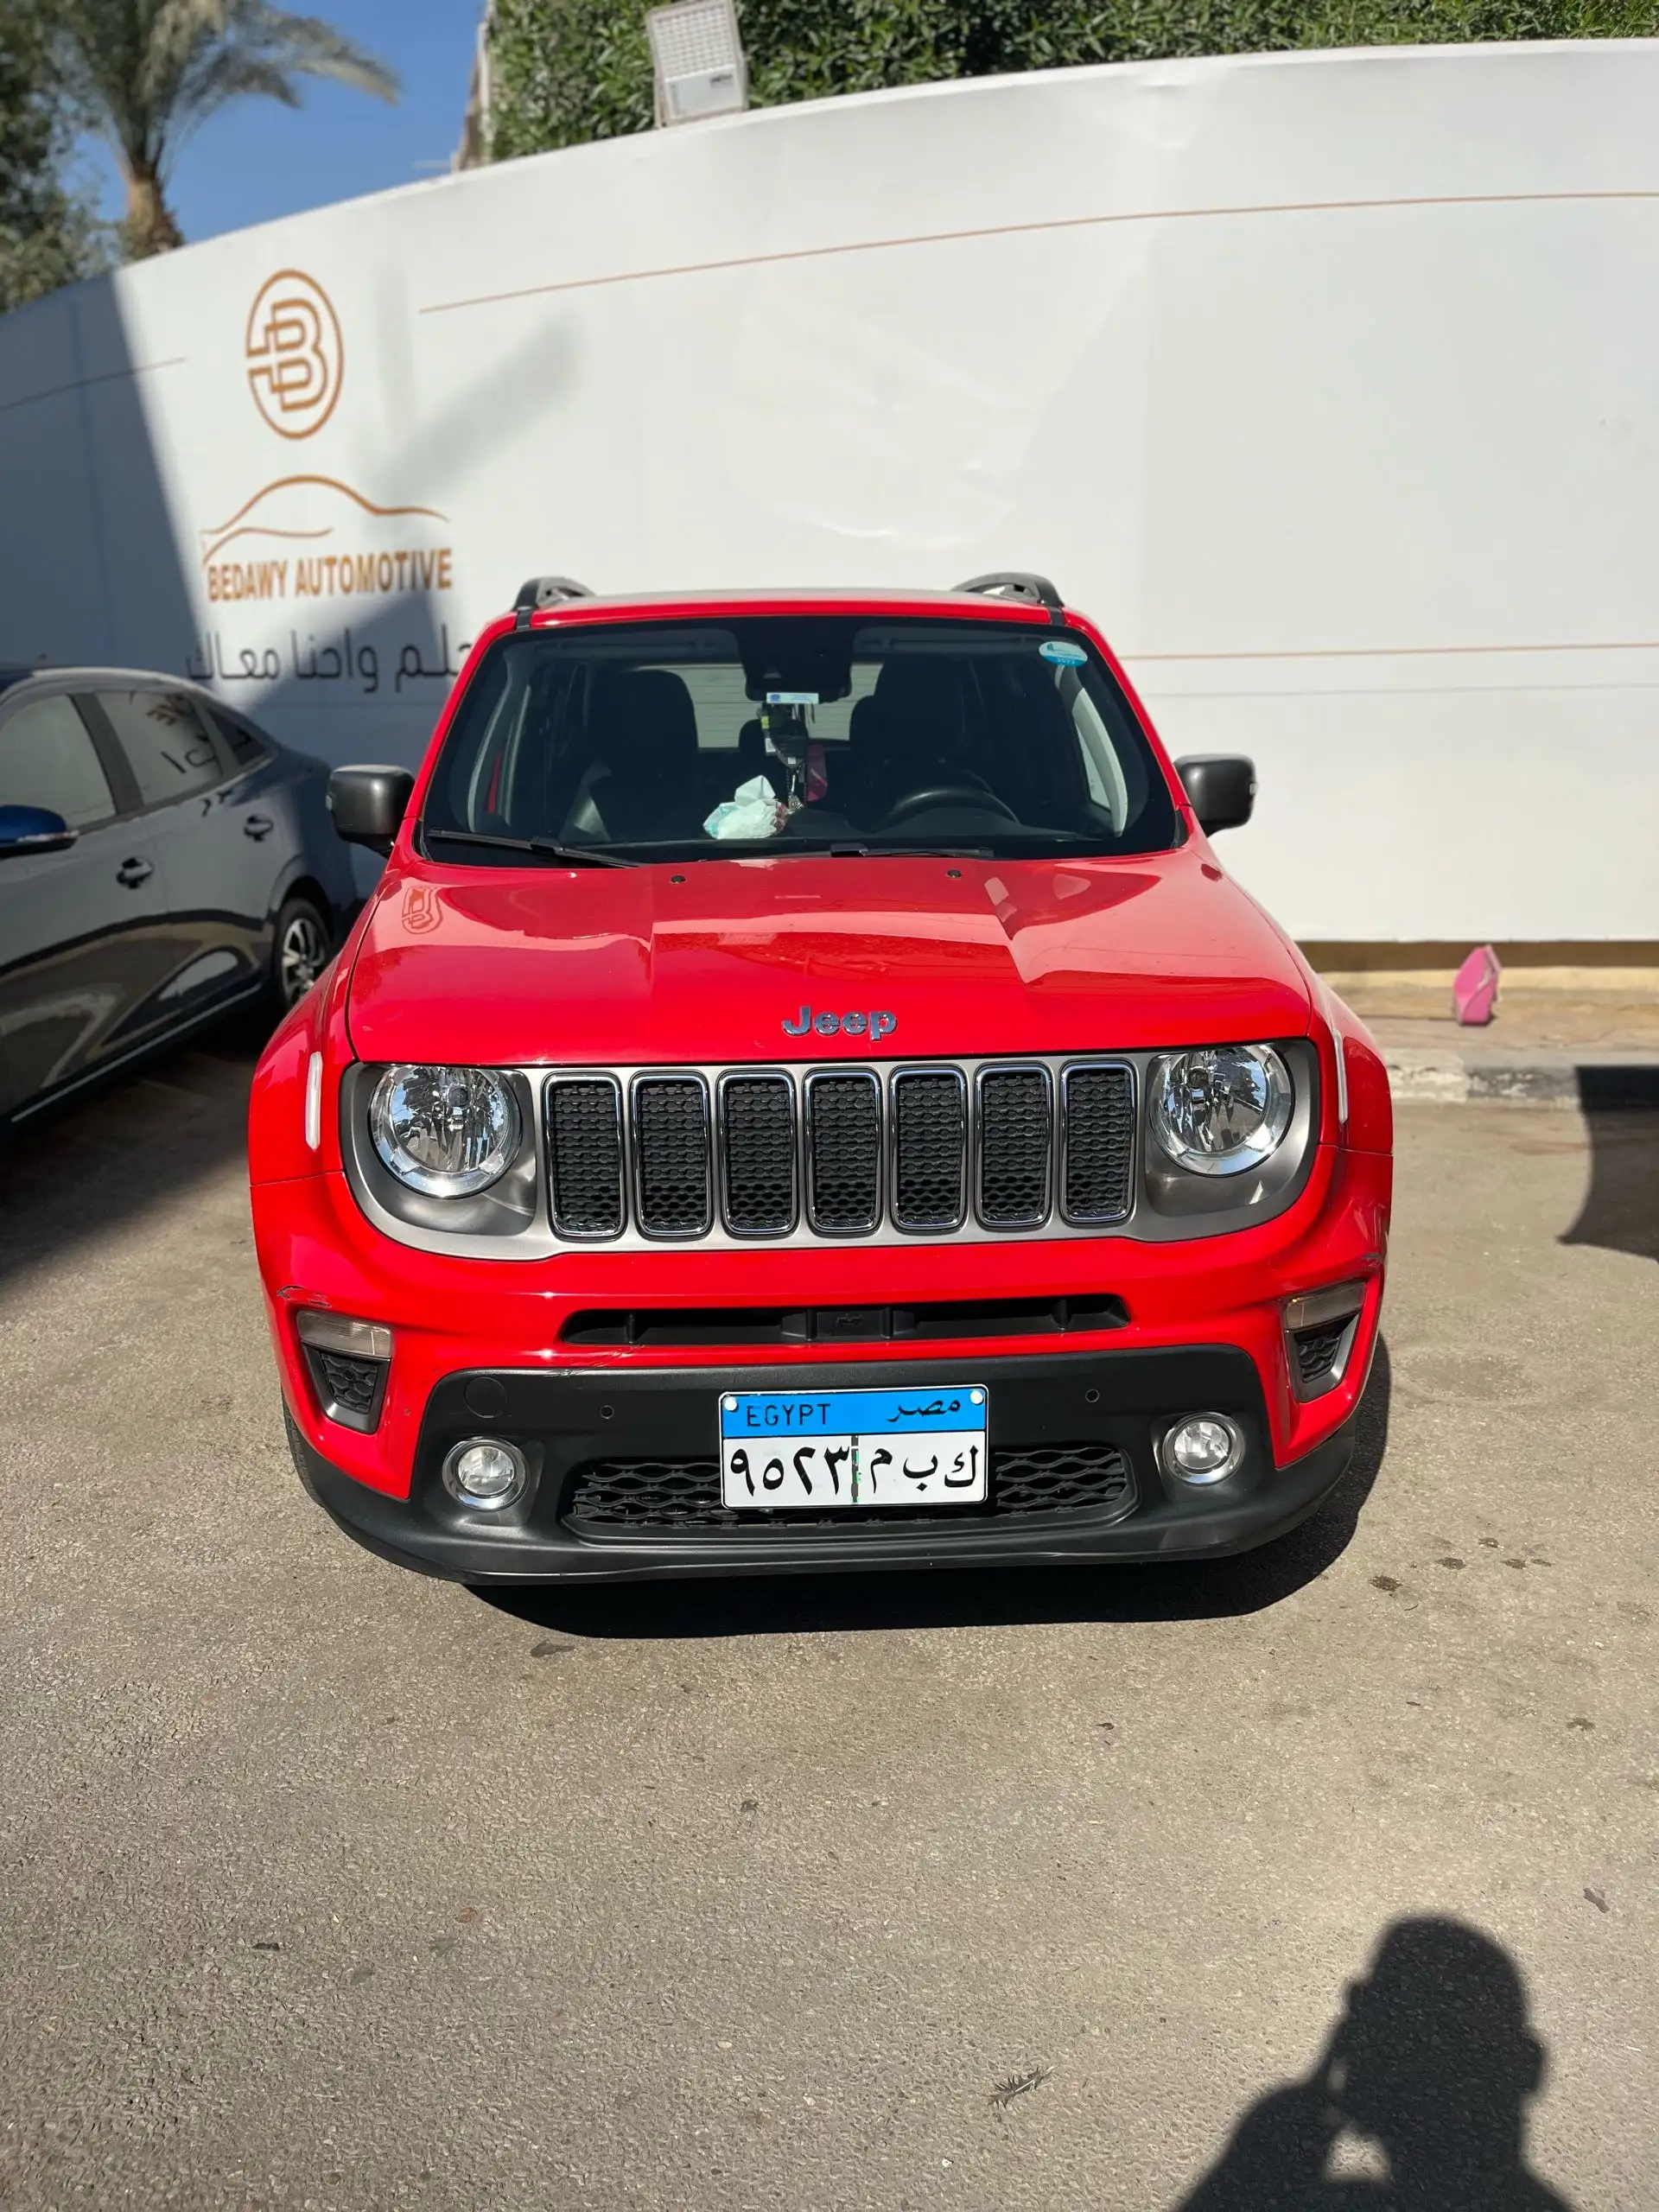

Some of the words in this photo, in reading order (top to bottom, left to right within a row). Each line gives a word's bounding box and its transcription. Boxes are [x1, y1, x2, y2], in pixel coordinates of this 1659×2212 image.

[207, 558, 288, 602] BEDAWY
[294, 548, 453, 596] AUTOMOTIVE
[184, 630, 281, 680] معاك
[289, 626, 379, 694] واحنا
[781, 1005, 898, 1042] Jeep
[746, 1402, 832, 1427] EGYPT
[887, 1398, 962, 1424] مصر
